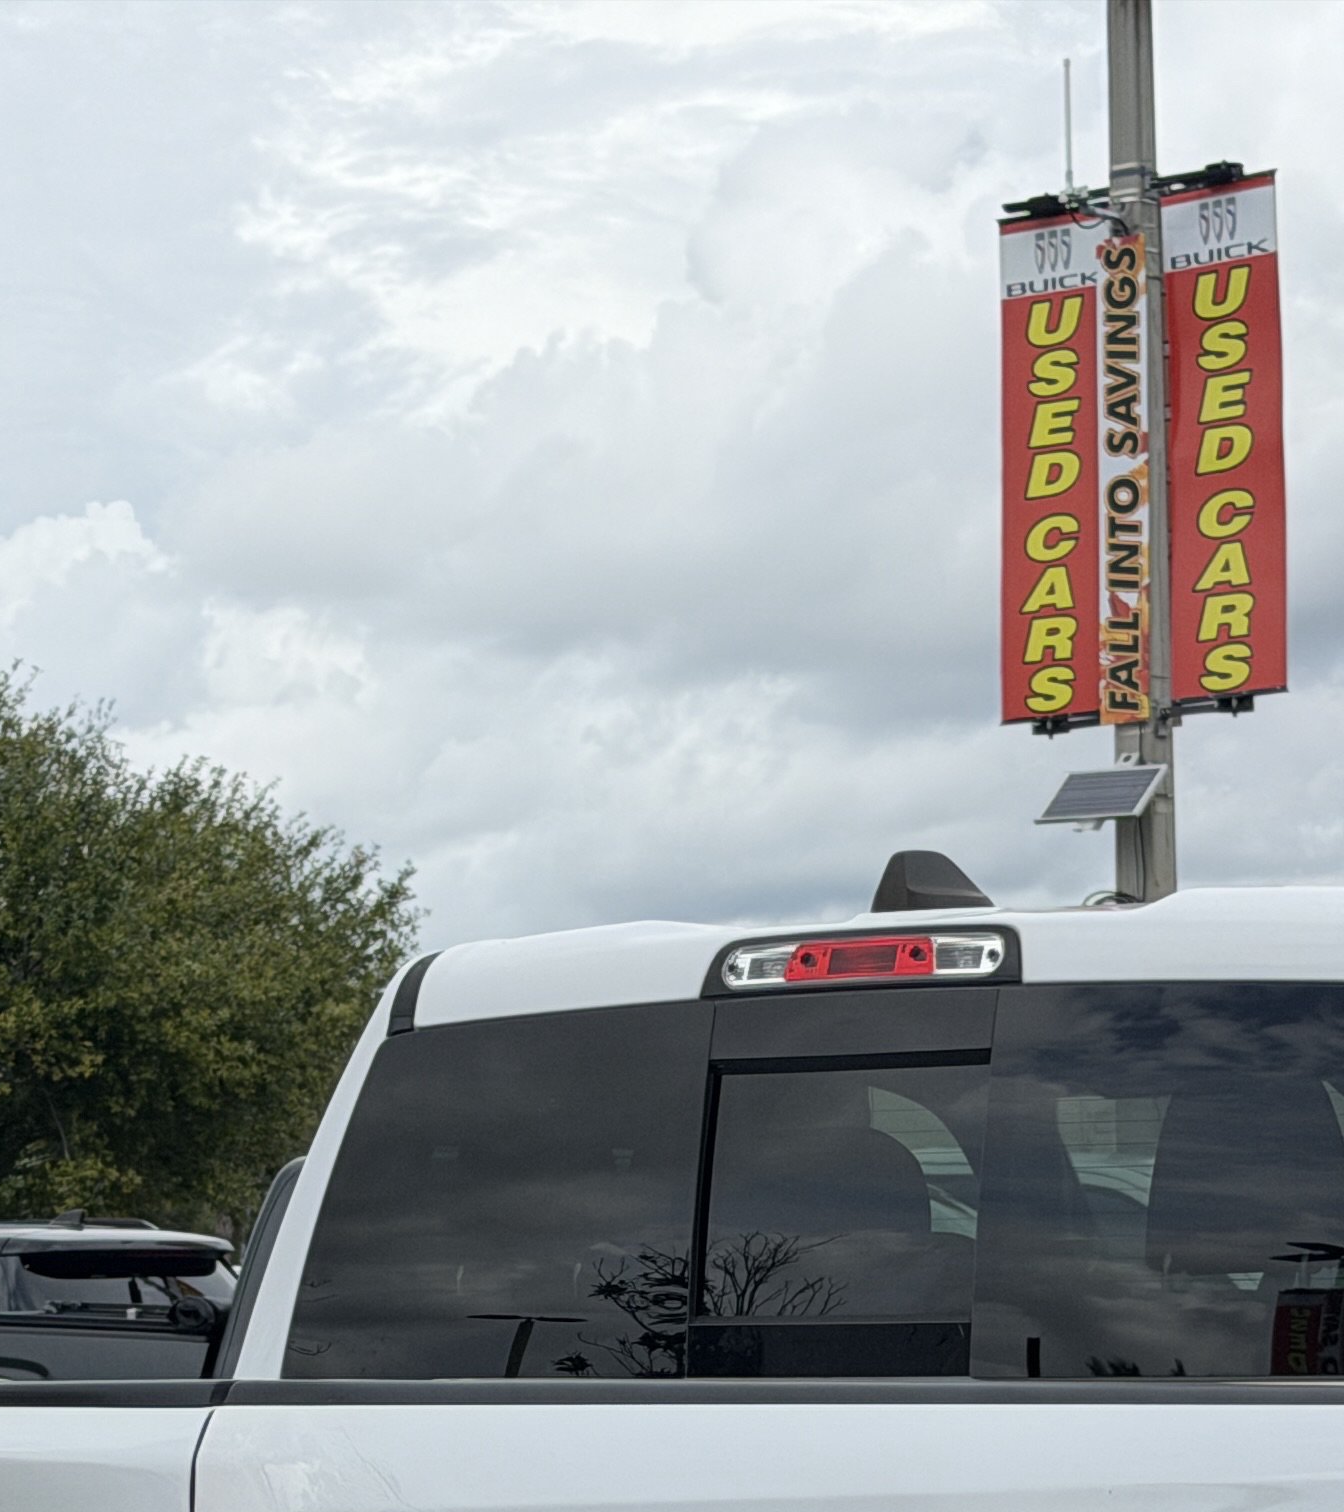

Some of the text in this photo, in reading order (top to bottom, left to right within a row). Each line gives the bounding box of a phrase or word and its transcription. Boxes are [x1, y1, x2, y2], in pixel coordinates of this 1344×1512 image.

[1006, 271, 1097, 298] BUICK
[1170, 239, 1270, 270] BUICK
[1019, 294, 1084, 713] USED CARS
[1103, 246, 1144, 713] FALL INTO SAVINGS
[1192, 265, 1255, 692] USED CARS
